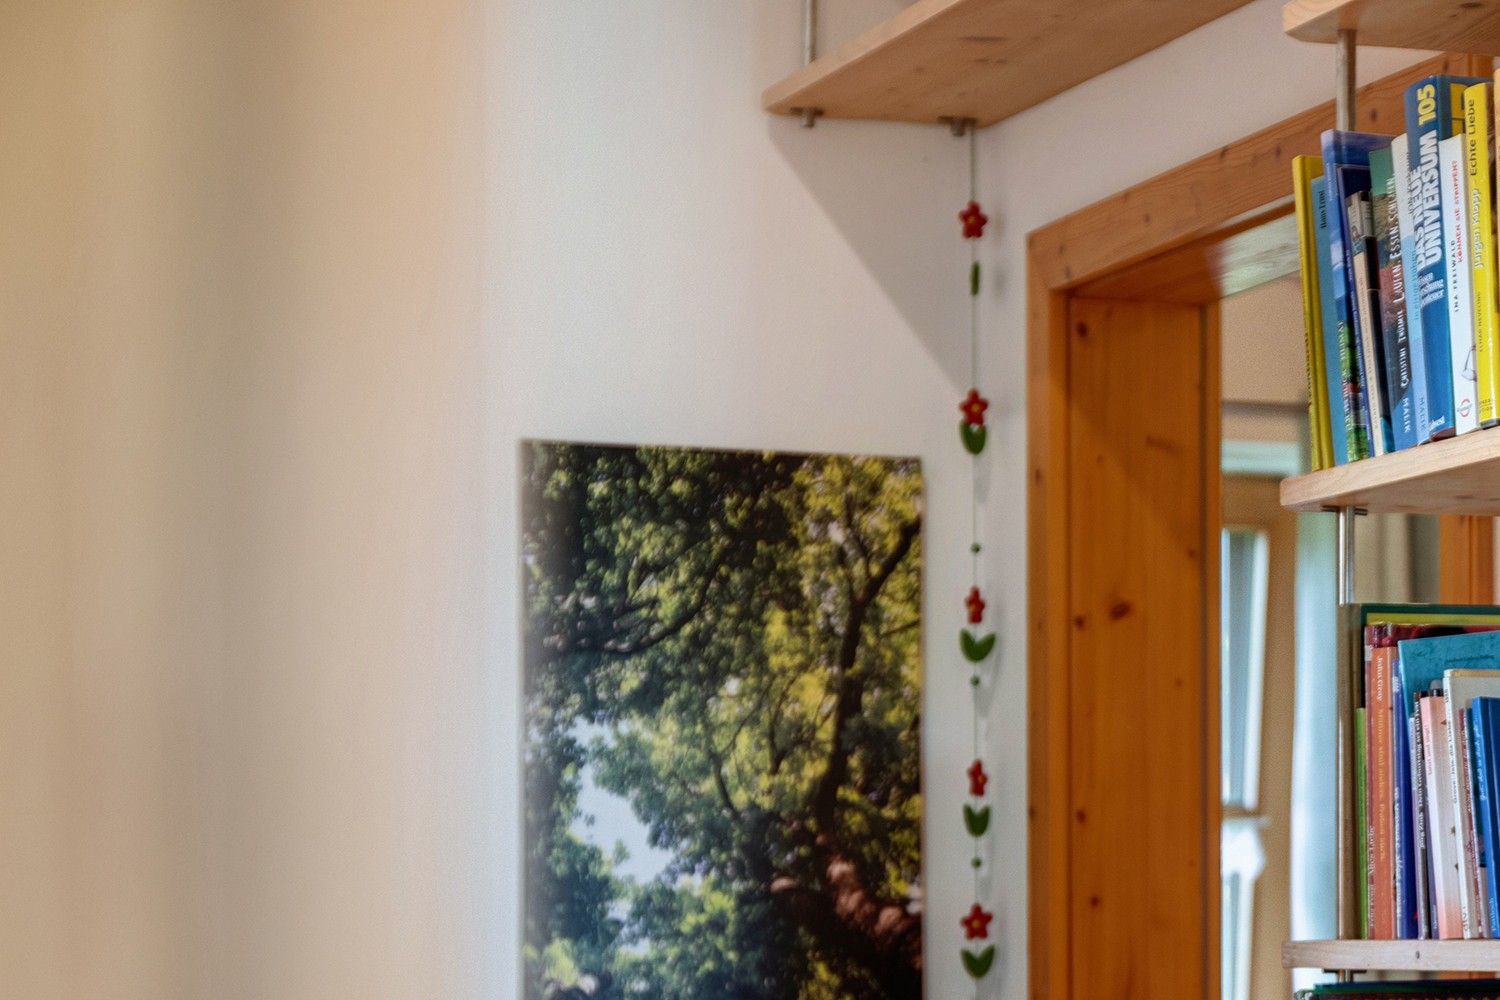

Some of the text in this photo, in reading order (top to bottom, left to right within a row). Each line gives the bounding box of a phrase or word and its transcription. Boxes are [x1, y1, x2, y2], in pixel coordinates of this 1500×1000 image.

[1416, 83, 1437, 126] 105
[1466, 98, 1478, 177] Echte Liebe
[1409, 165, 1425, 230] NEUE
[1419, 129, 1443, 265] UNIVERSUM
[1471, 187, 1482, 224] Klopp
